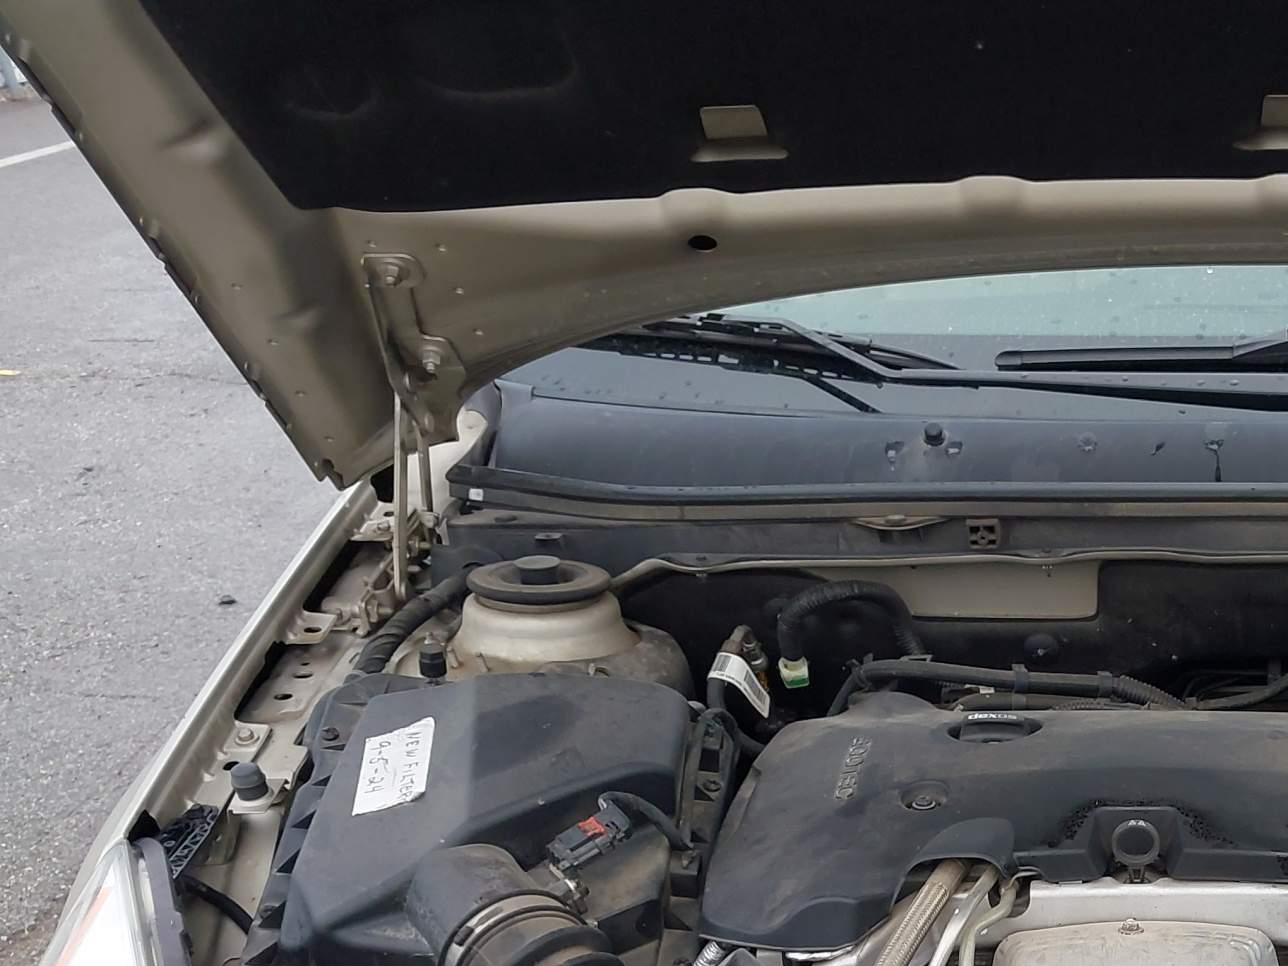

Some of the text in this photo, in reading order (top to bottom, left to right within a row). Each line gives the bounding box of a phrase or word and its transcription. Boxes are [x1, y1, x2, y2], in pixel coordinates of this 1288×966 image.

[967, 712, 1017, 720] dexos
[406, 732, 421, 758] NEW
[365, 740, 392, 794] 9-5-24
